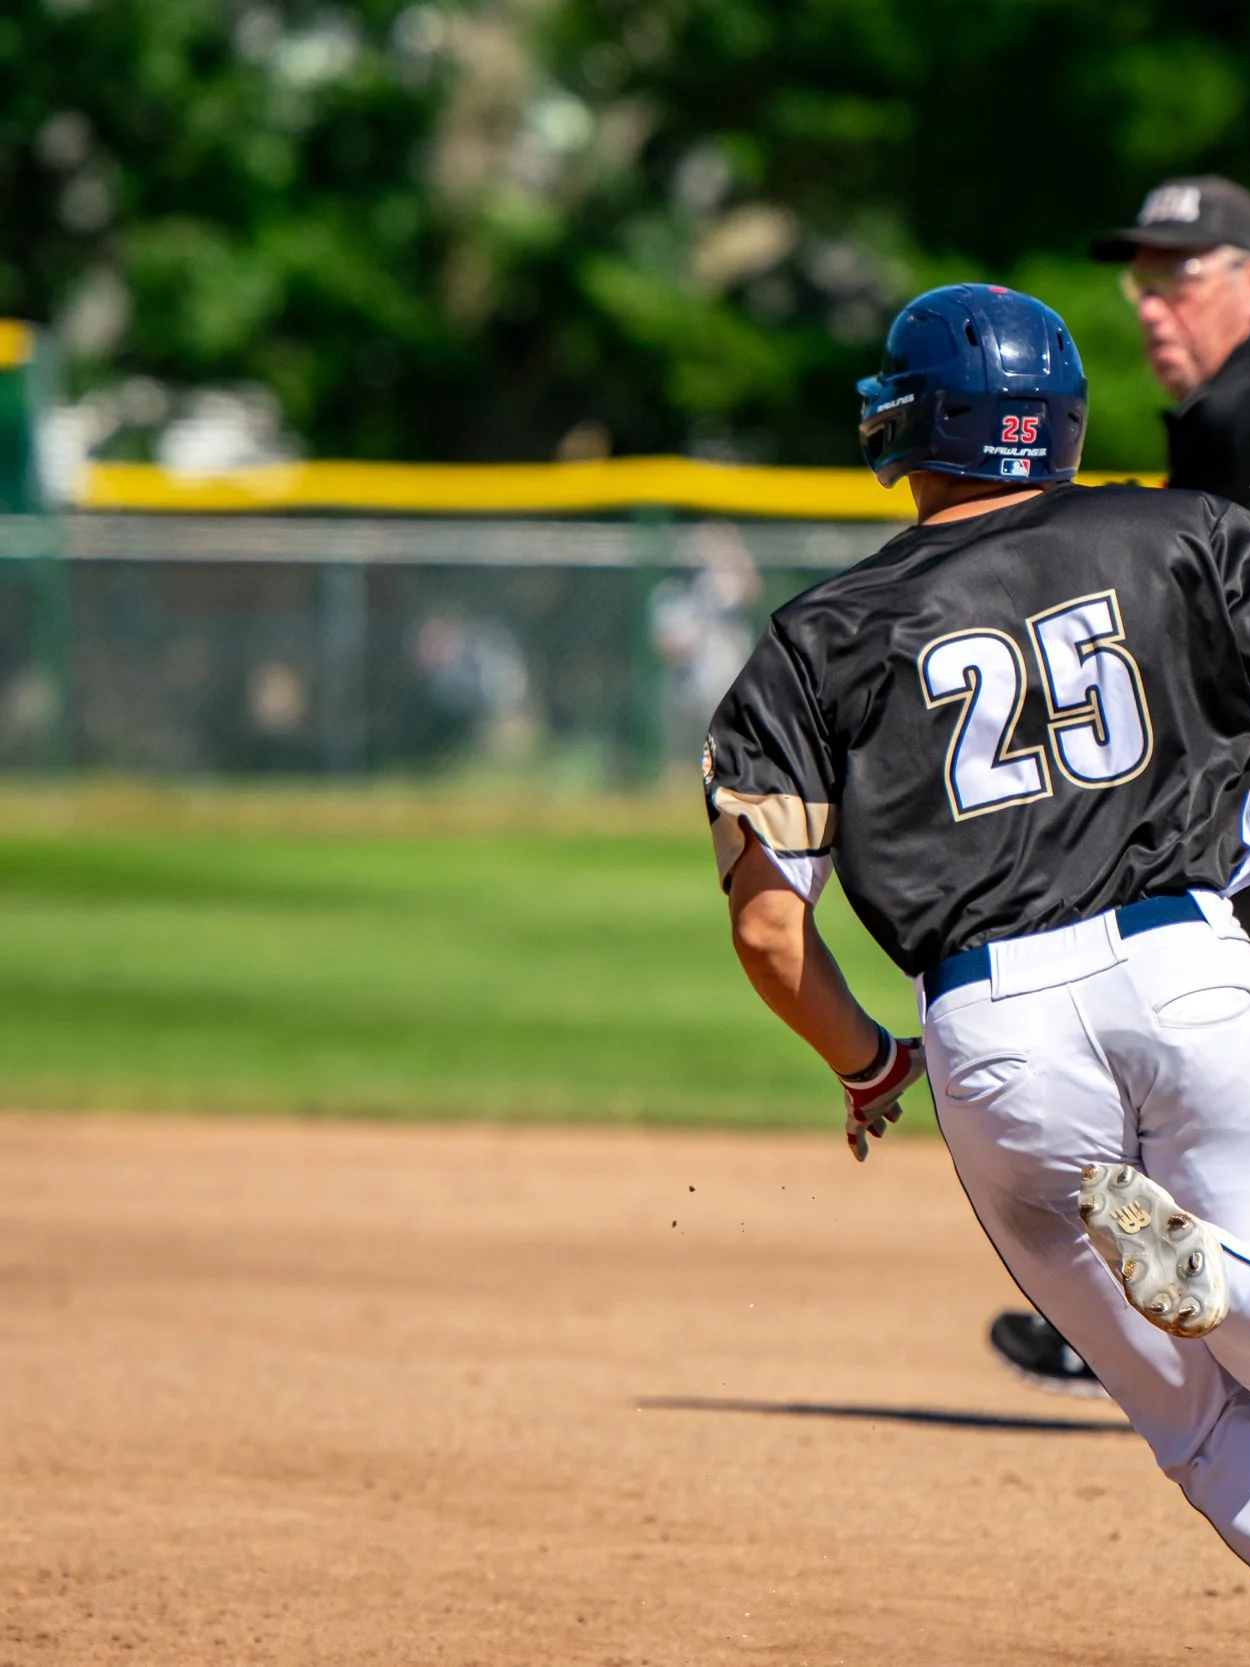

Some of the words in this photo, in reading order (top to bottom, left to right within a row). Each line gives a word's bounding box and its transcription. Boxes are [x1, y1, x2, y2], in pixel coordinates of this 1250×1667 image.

[1002, 415, 1039, 443] 25
[983, 445, 1047, 457] RAWLINGS
[917, 588, 1154, 822] 25
